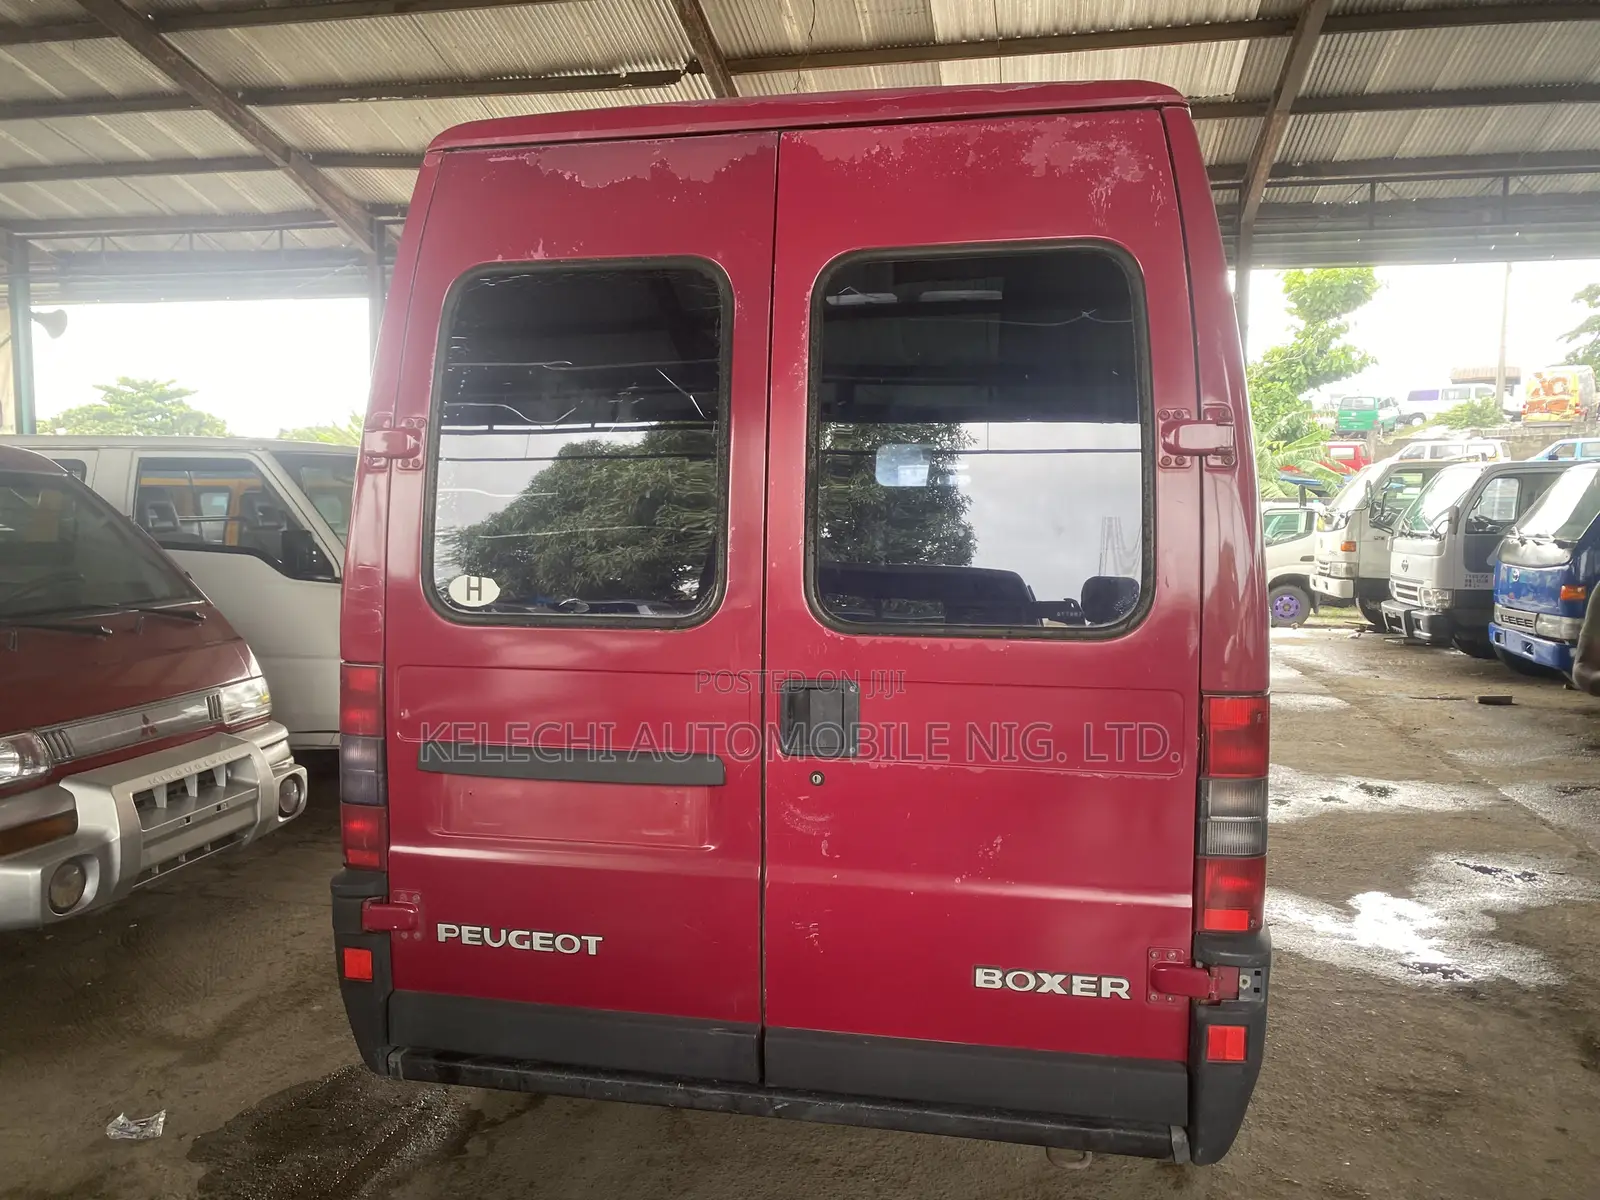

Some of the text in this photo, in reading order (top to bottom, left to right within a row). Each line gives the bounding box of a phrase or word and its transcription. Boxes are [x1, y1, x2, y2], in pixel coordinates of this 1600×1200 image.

[466, 576, 483, 602] H
[436, 922, 604, 956] PEUGEOT
[974, 966, 1132, 1000] BOXER
